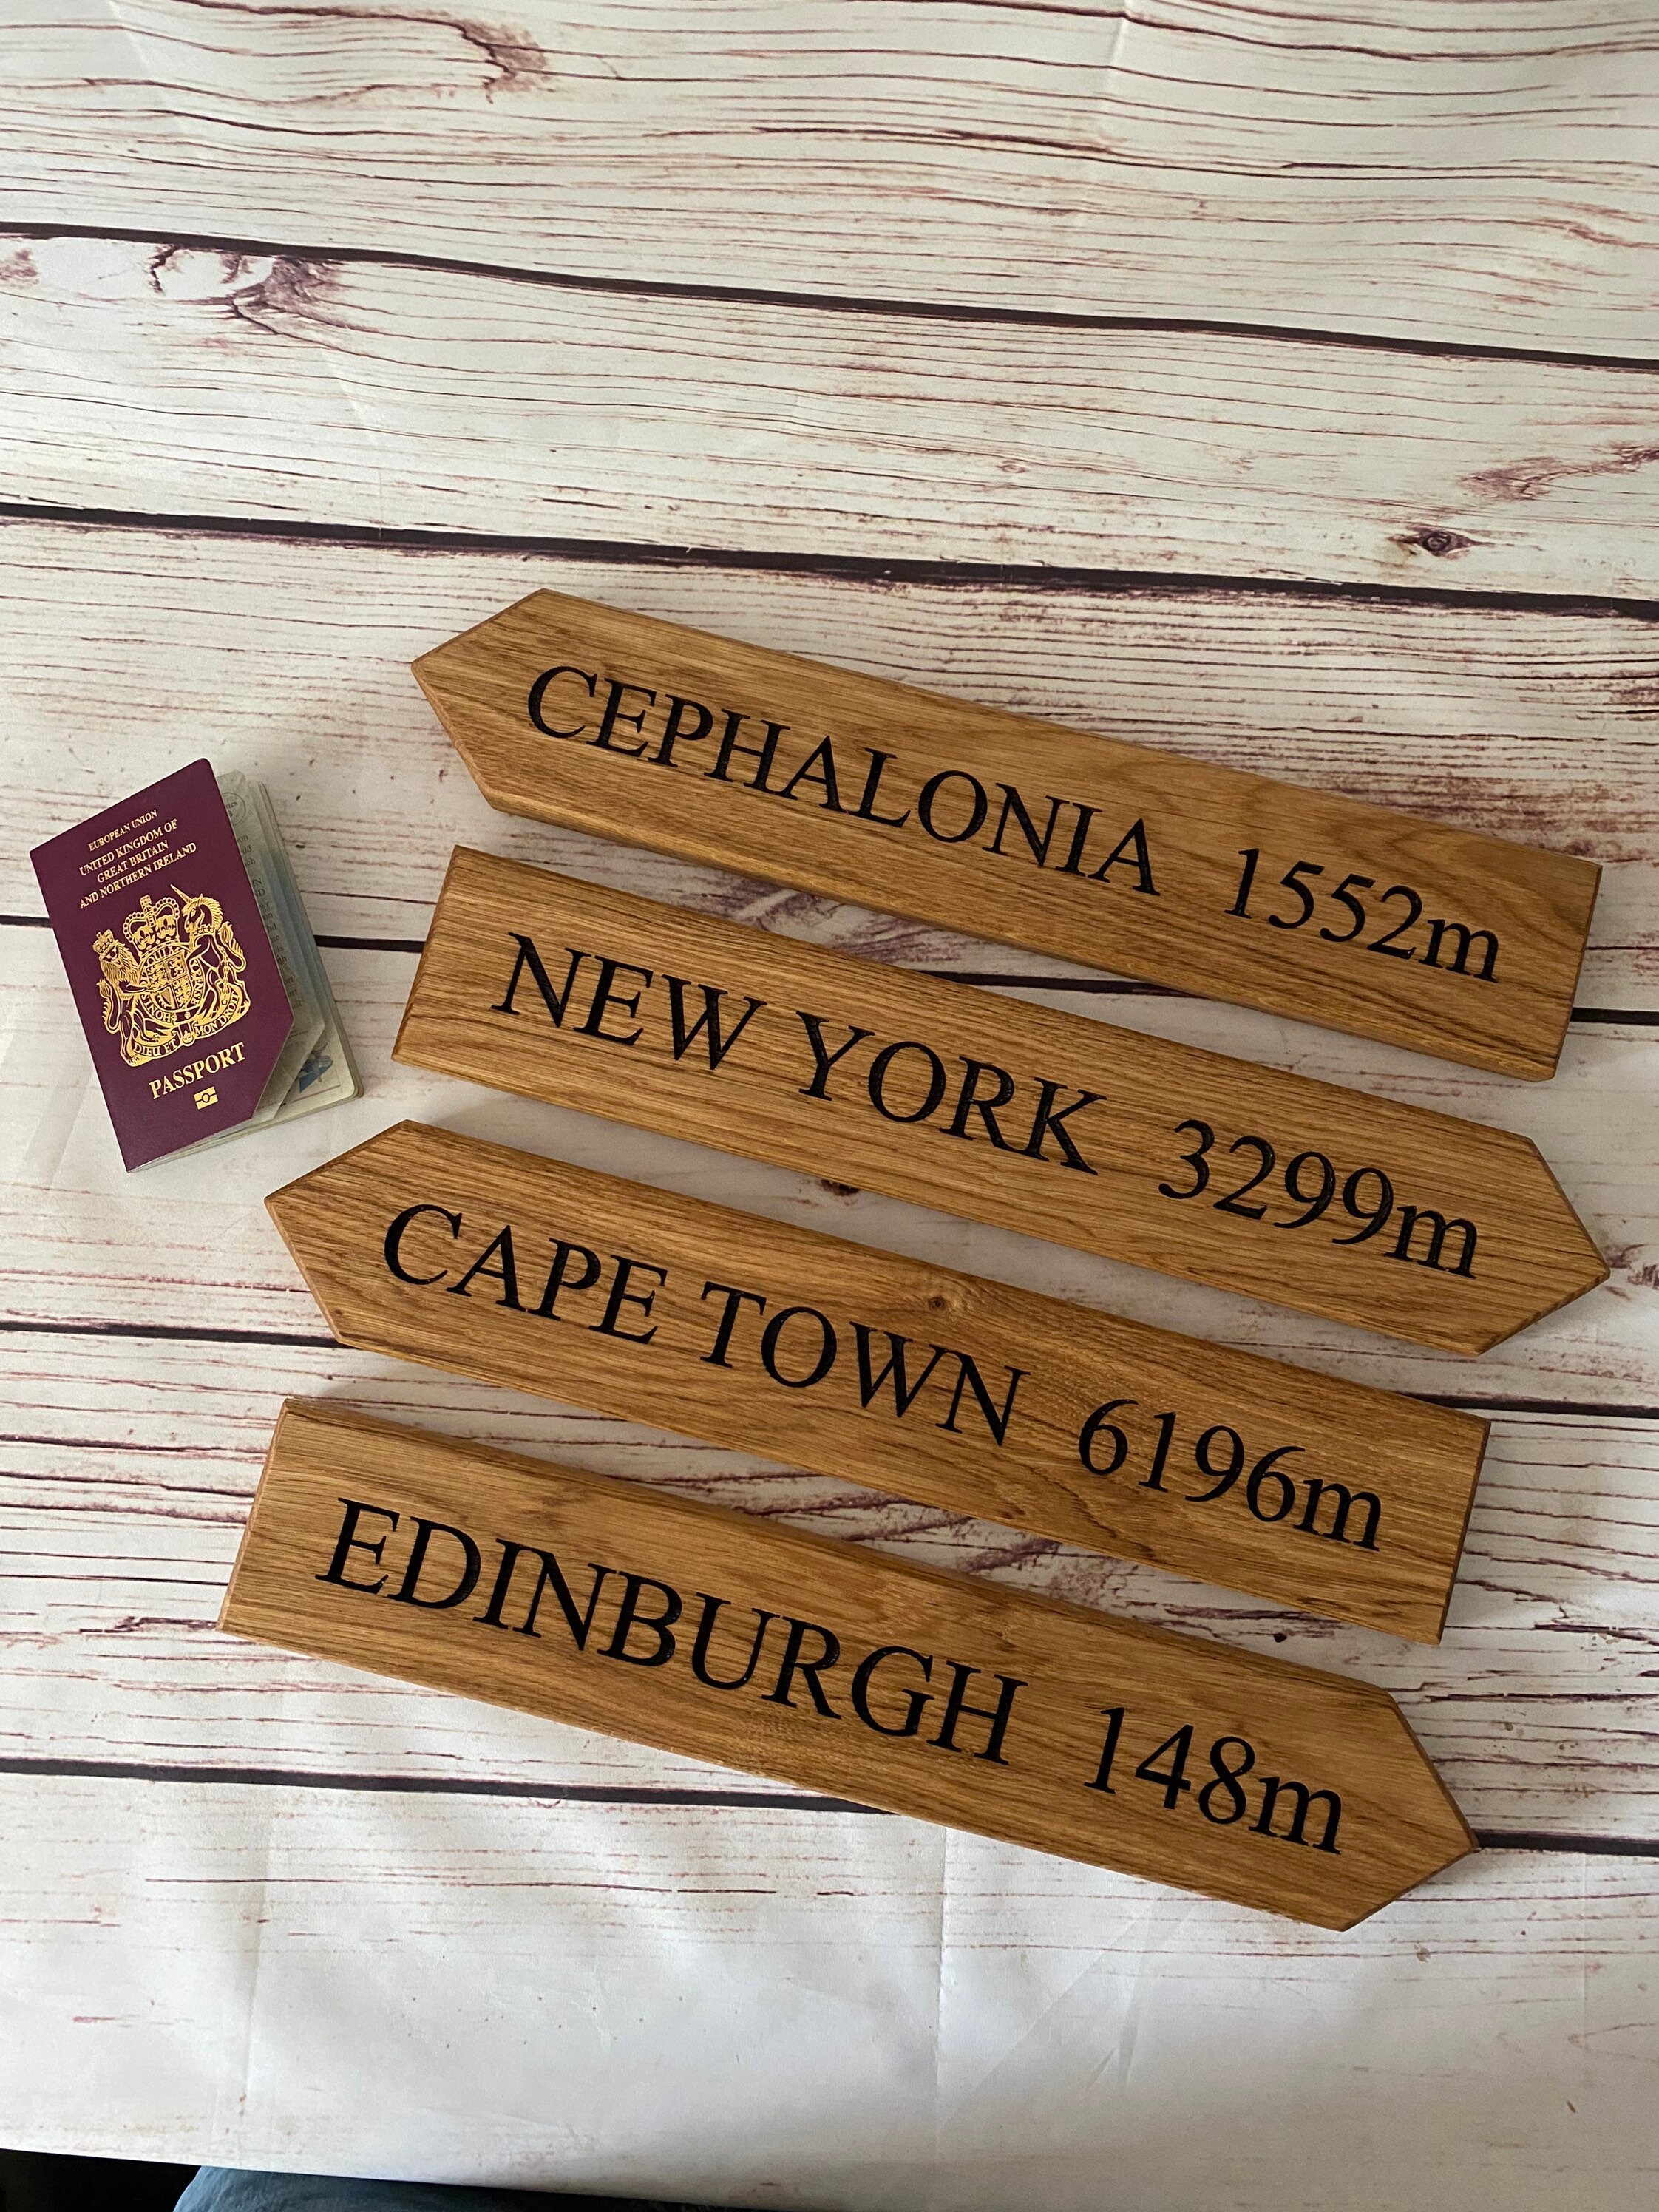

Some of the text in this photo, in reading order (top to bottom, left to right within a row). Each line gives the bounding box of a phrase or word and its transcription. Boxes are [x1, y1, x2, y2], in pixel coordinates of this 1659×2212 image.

[79, 818, 177, 876] UNITED KINGDOM OF
[88, 810, 157, 851] EUROPEAN UNION
[528, 666, 1501, 983] CEPHALONIA 1552m
[80, 842, 197, 909] AND NORTHERN IRELAND
[97, 840, 169, 883] GREAT BRITAIN
[133, 991, 238, 1056] DIEU ET MON DROIT
[144, 1000, 172, 1023] HONI
[149, 1042, 246, 1099] PASSPORT
[491, 932, 1479, 1280] NEW YORK 3299m
[384, 1204, 1380, 1552] CAPE TOWN 6196m
[315, 1498, 1343, 1856] EDINBURGH 148m
